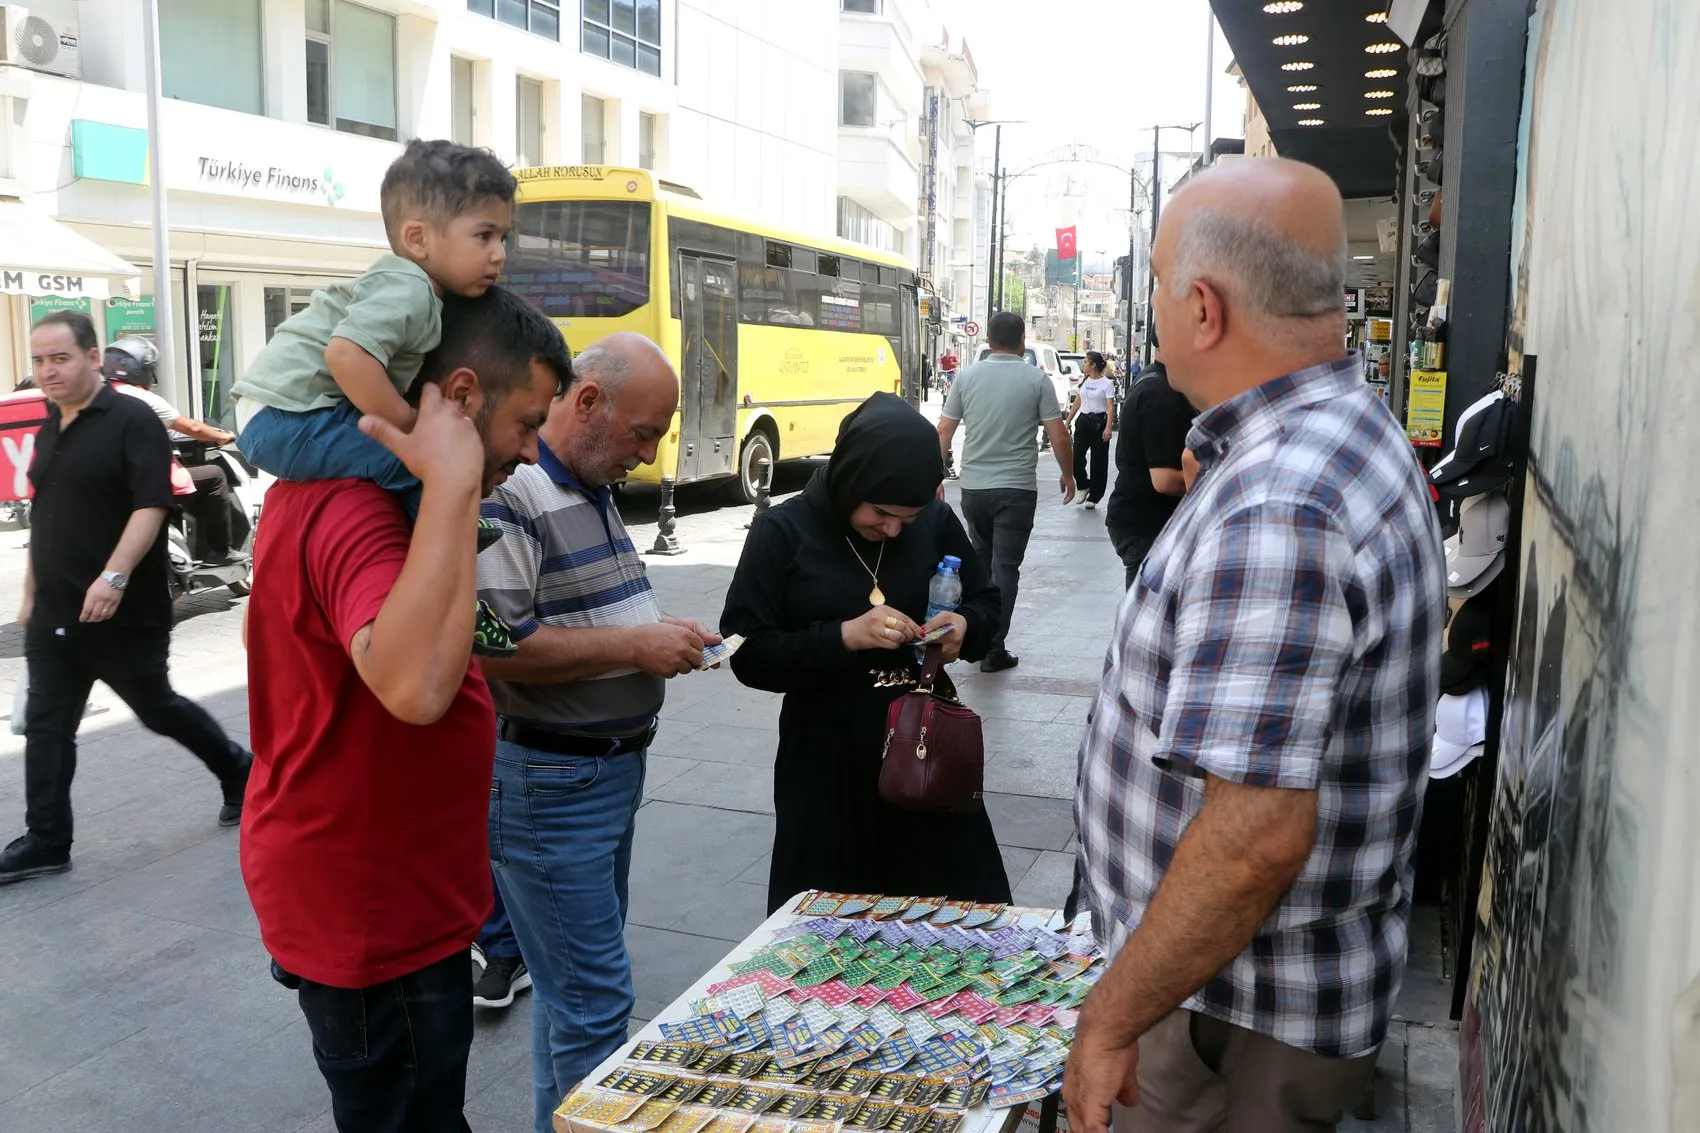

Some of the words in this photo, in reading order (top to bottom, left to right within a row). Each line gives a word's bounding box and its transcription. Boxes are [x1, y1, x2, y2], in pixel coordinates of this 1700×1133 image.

[198, 156, 262, 187] Türkiye
[268, 167, 318, 190] Finans
[518, 167, 550, 180] ALLAH
[553, 166, 603, 178] KORUSUN
[0, 271, 23, 290] M
[38, 274, 83, 292] GSM
[1418, 375, 1440, 384] Fujita
